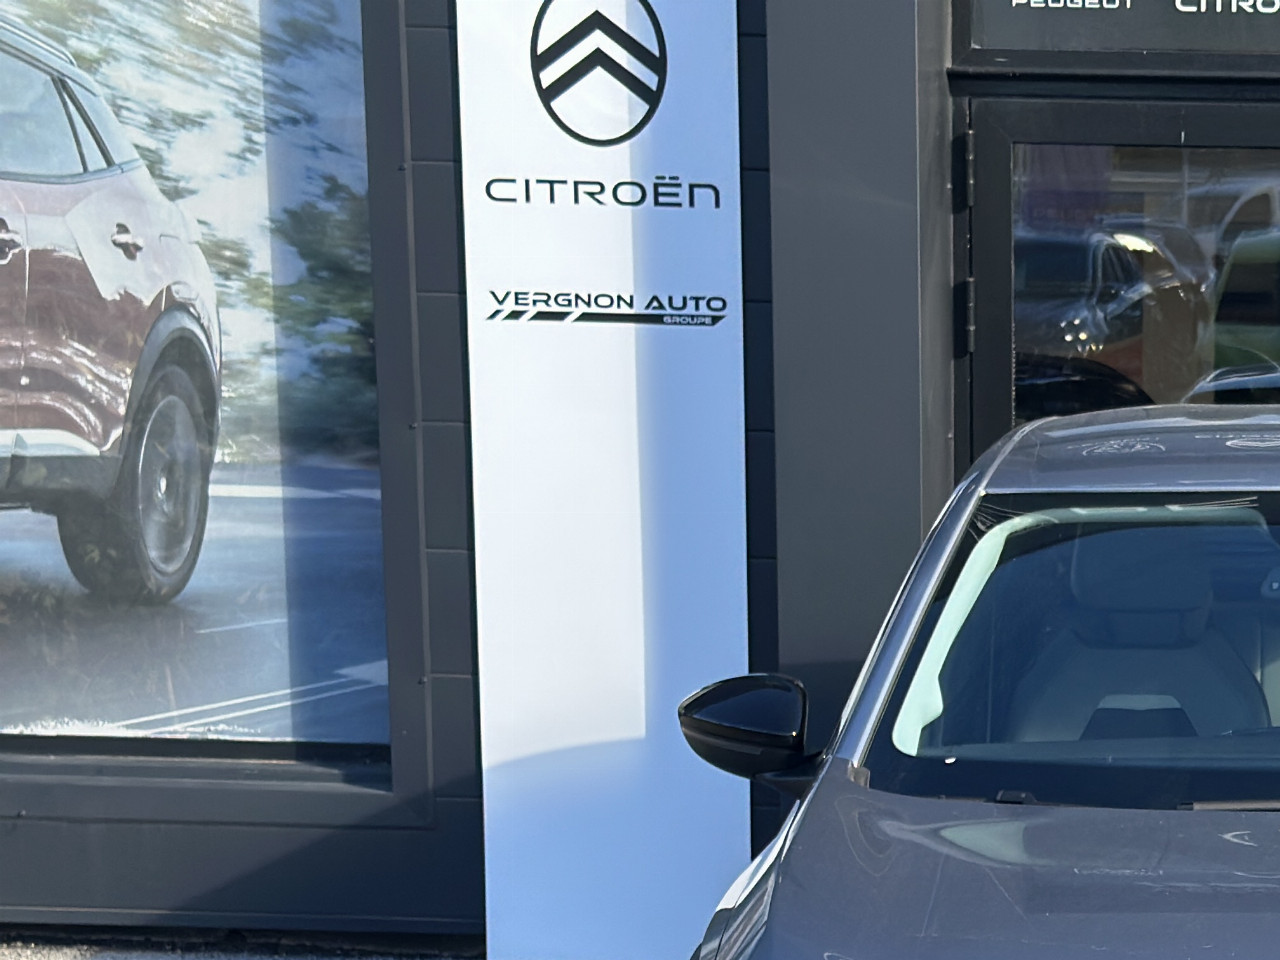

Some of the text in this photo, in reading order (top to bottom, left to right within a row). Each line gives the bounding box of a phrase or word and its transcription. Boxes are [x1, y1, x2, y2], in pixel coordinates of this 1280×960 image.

[489, 290, 727, 312] VERGNON AUTO
[662, 314, 713, 326] GROUPE
